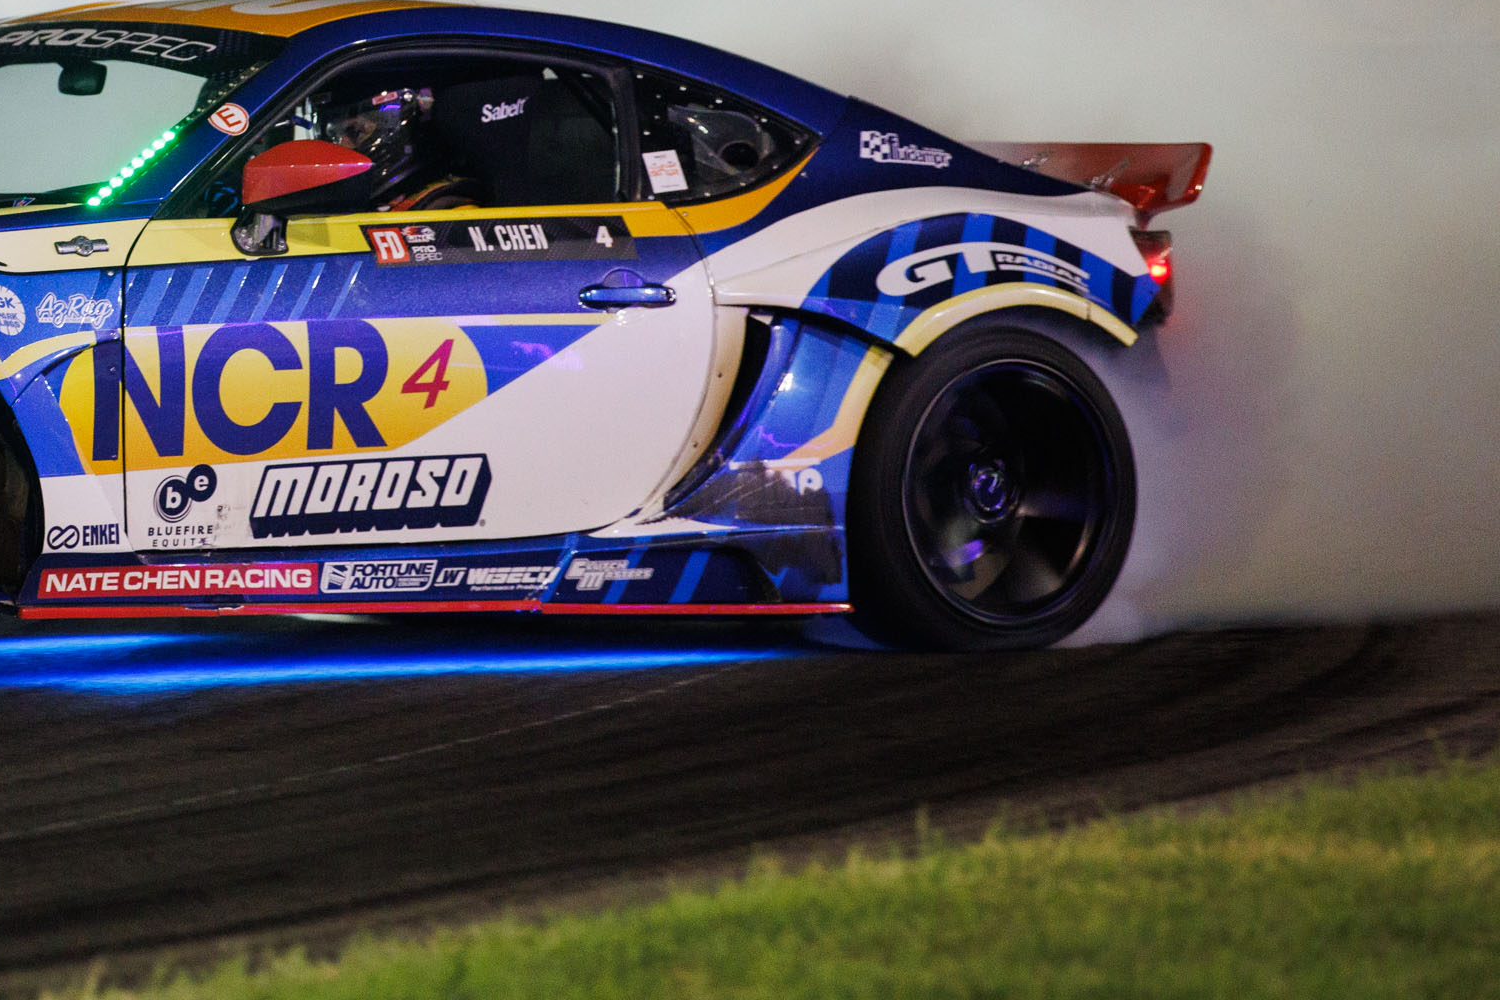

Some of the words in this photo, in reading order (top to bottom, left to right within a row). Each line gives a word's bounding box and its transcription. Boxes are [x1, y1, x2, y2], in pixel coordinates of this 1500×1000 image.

[372, 230, 406, 261] FD
[468, 226, 493, 251] N.
[494, 224, 549, 251] CHEN
[596, 225, 613, 248] 4
[412, 245, 437, 254] PRO
[415, 252, 443, 262] SPEC
[876, 242, 997, 296] GT
[995, 253, 1090, 287] RADIAL
[92, 318, 389, 461] NCR
[401, 338, 454, 408] 4
[251, 455, 487, 522] MOROSO
[82, 523, 120, 547] ENKEI
[148, 525, 213, 537] BLUEFIRE
[45, 571, 120, 593] NATE
[123, 569, 200, 590] CHEN
[204, 568, 312, 589] RACING
[351, 562, 434, 577] FORTUNE
[351, 576, 397, 589] AUTO
